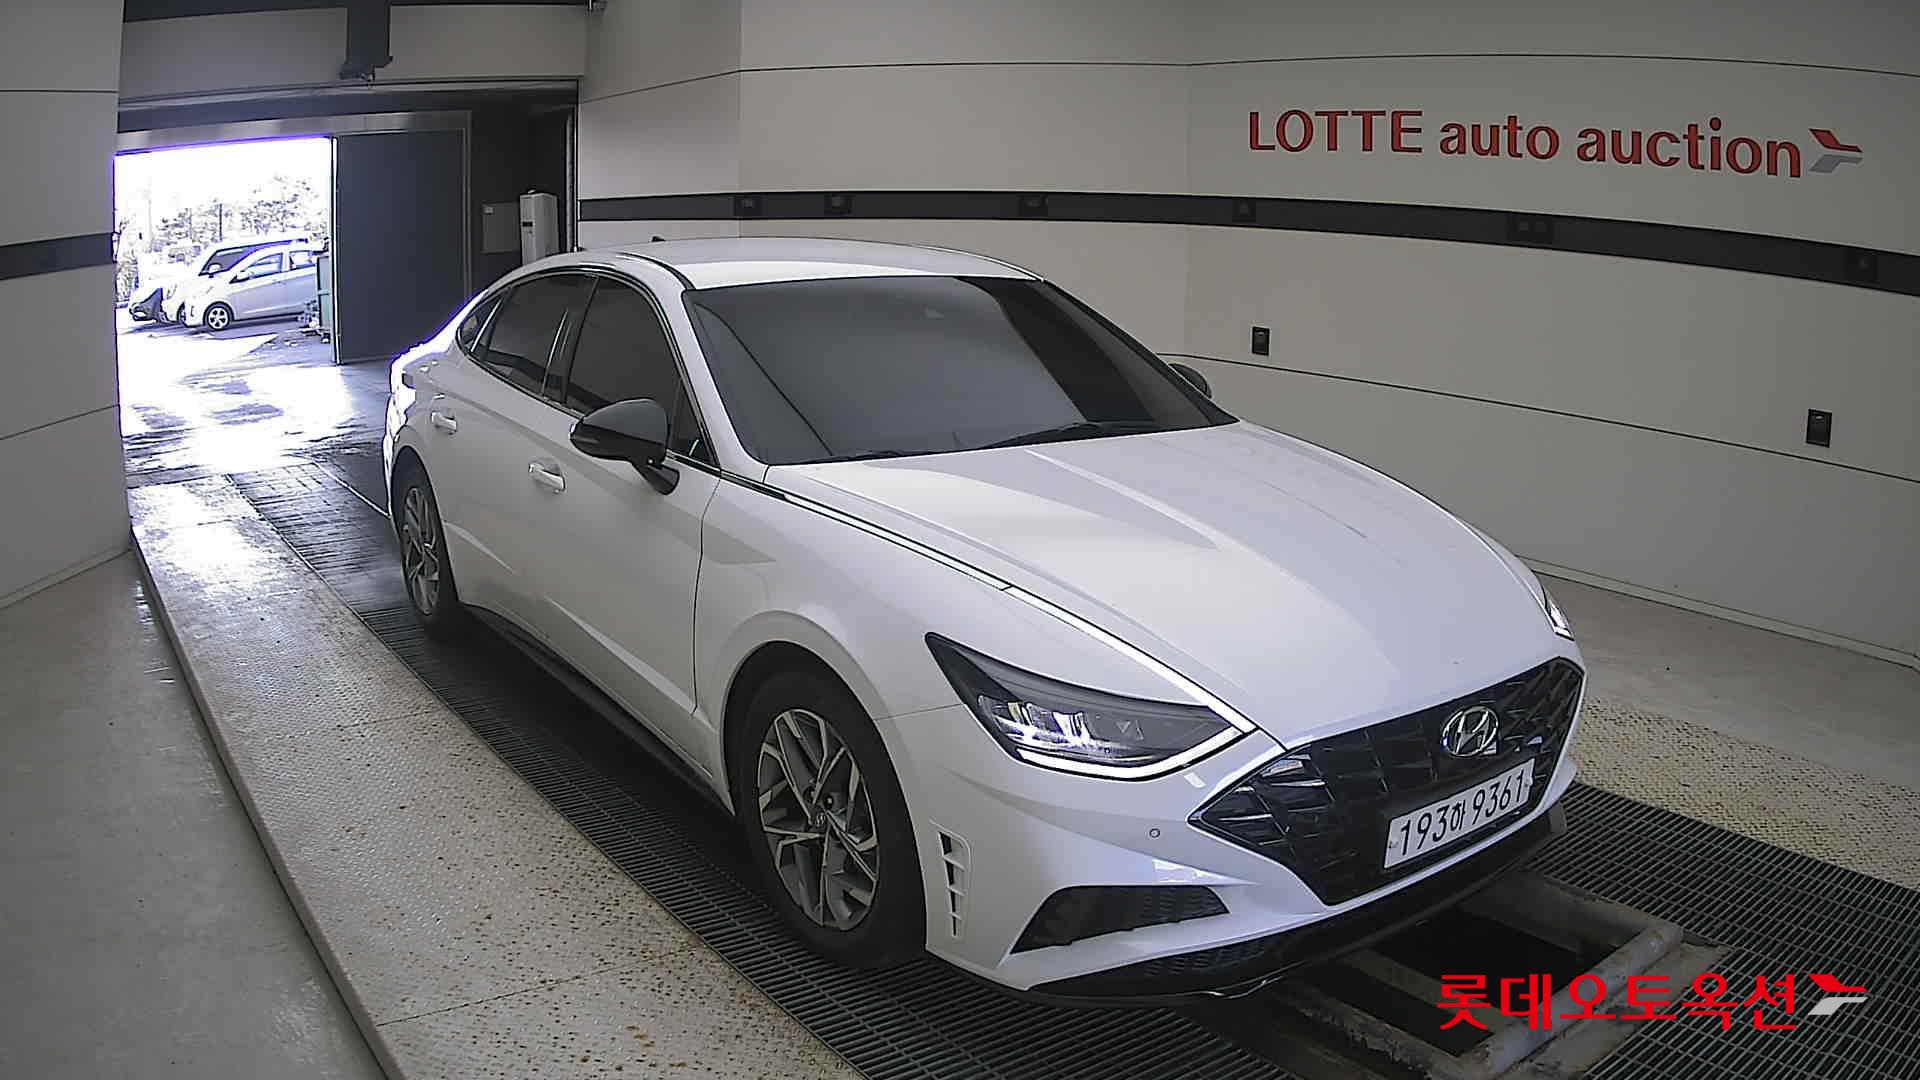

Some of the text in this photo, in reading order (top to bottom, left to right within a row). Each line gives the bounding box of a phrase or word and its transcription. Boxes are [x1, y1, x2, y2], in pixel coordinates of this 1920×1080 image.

[1248, 109, 1802, 179] LOTTE auto auction
[1471, 769, 1525, 825] 9361
